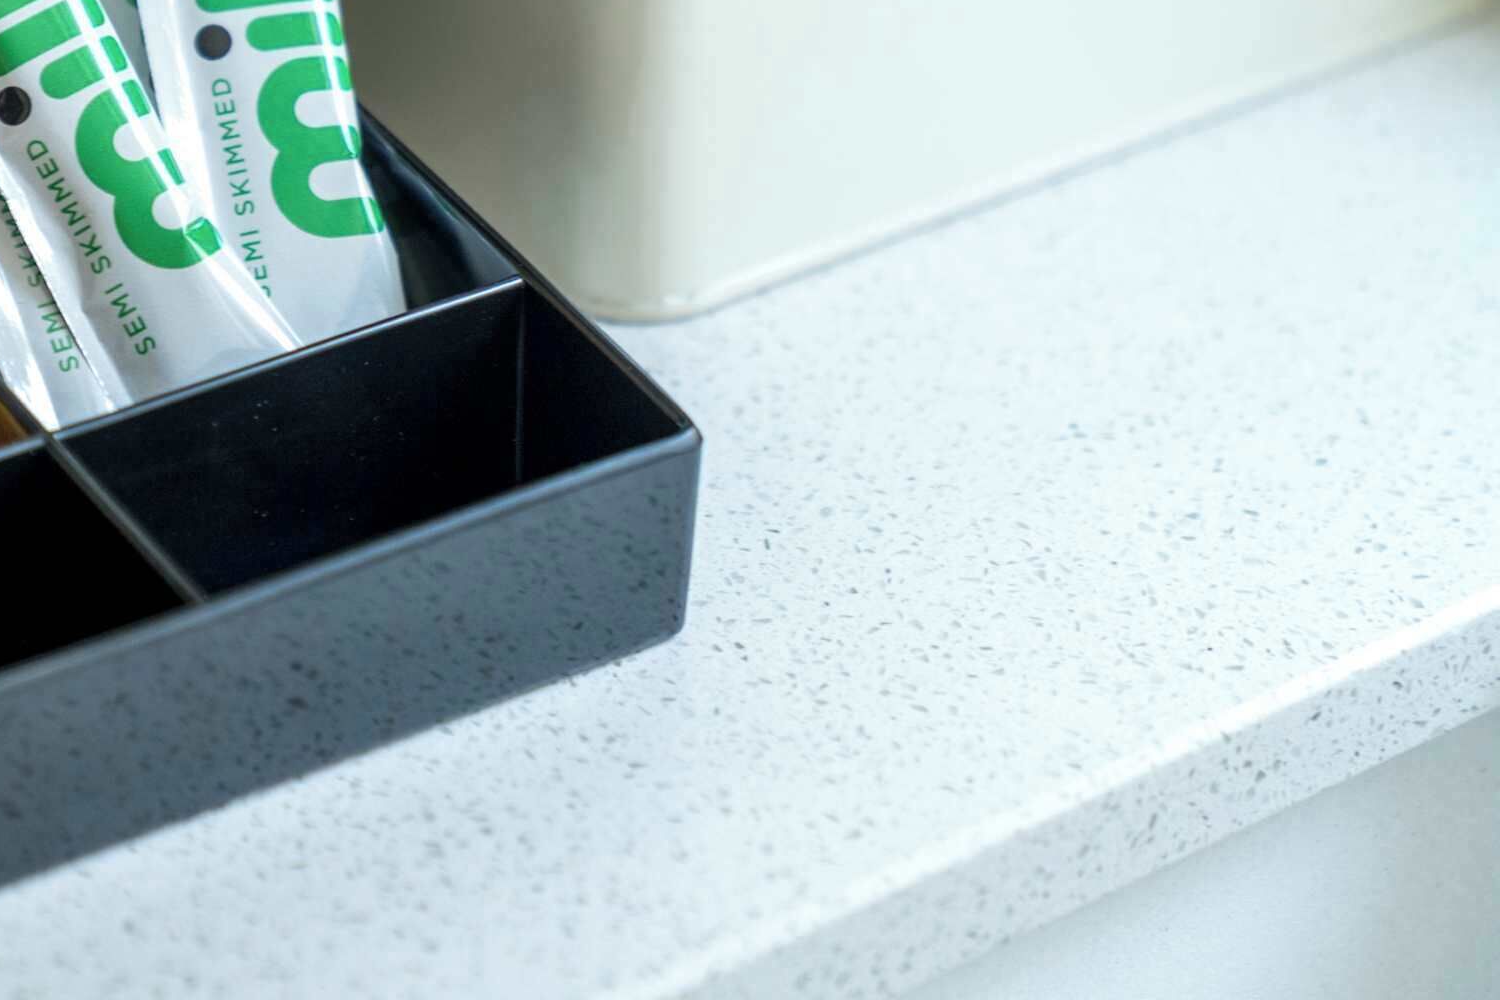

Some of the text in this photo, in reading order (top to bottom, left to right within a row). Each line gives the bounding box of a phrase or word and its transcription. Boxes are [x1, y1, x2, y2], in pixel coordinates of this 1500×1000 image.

[212, 77, 257, 217] SKIMMED
[26, 138, 157, 357] SEMI SKIMMED
[37, 298, 80, 374] SEMI
